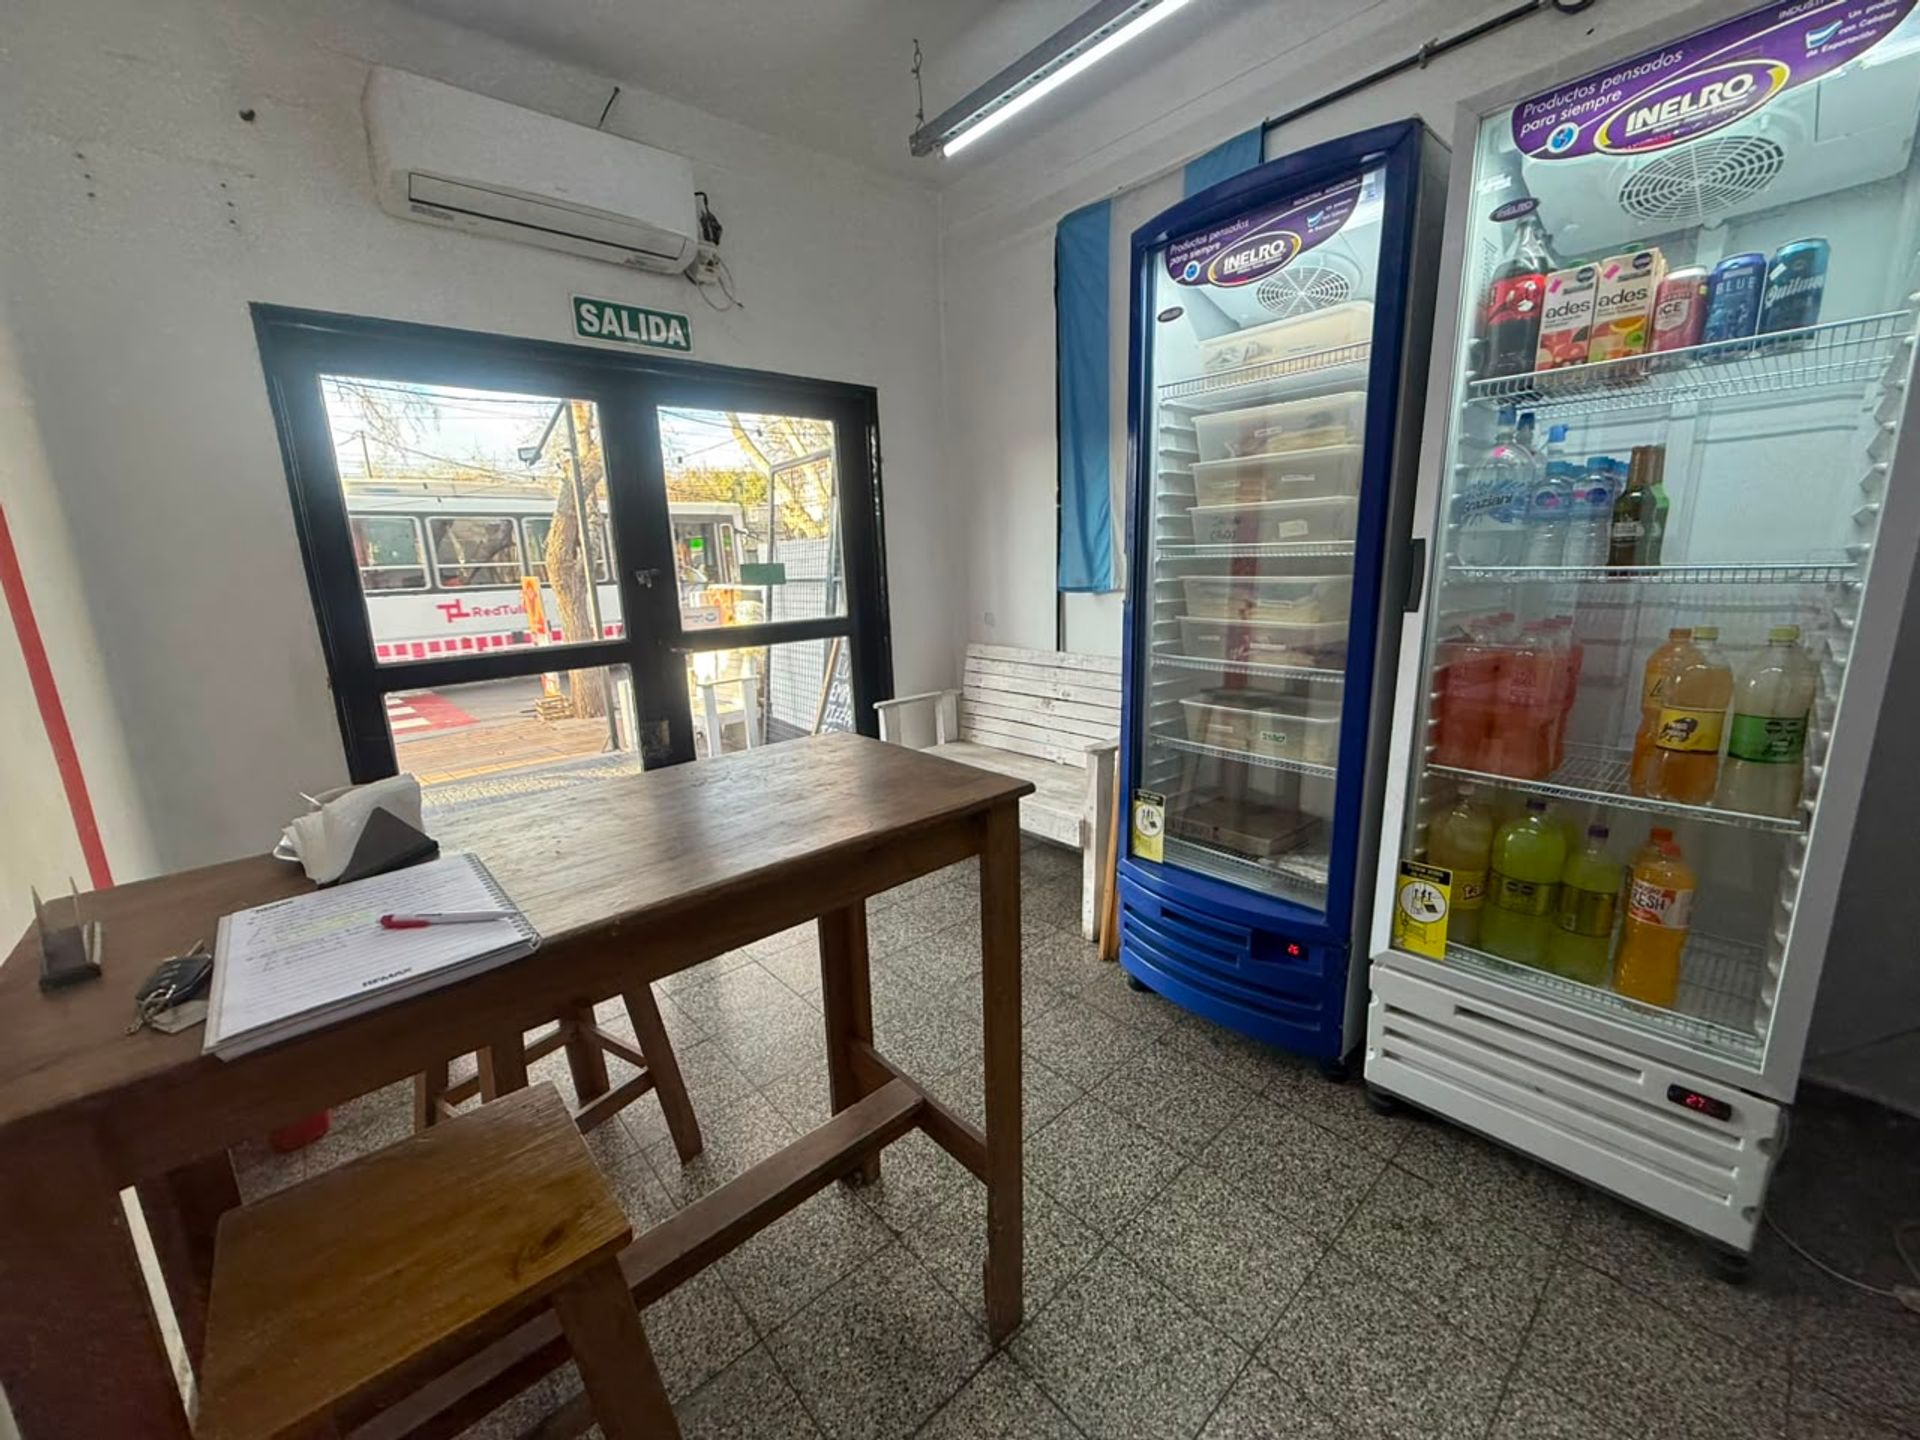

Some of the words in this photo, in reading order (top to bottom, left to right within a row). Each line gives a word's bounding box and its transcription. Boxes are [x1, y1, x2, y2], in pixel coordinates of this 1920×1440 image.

[1523, 83, 1596, 120] Productos
[1600, 49, 1684, 94] pensados
[1626, 72, 1756, 133] INELRO
[1519, 112, 1557, 139] para
[1560, 89, 1623, 123] siempre
[1222, 239, 1285, 275] INELRO
[1599, 287, 1649, 307] ades
[1715, 276, 1758, 297] BLUE
[579, 303, 688, 347] SALIDA
[1545, 300, 1592, 319] ades
[1658, 300, 1682, 316] ICE
